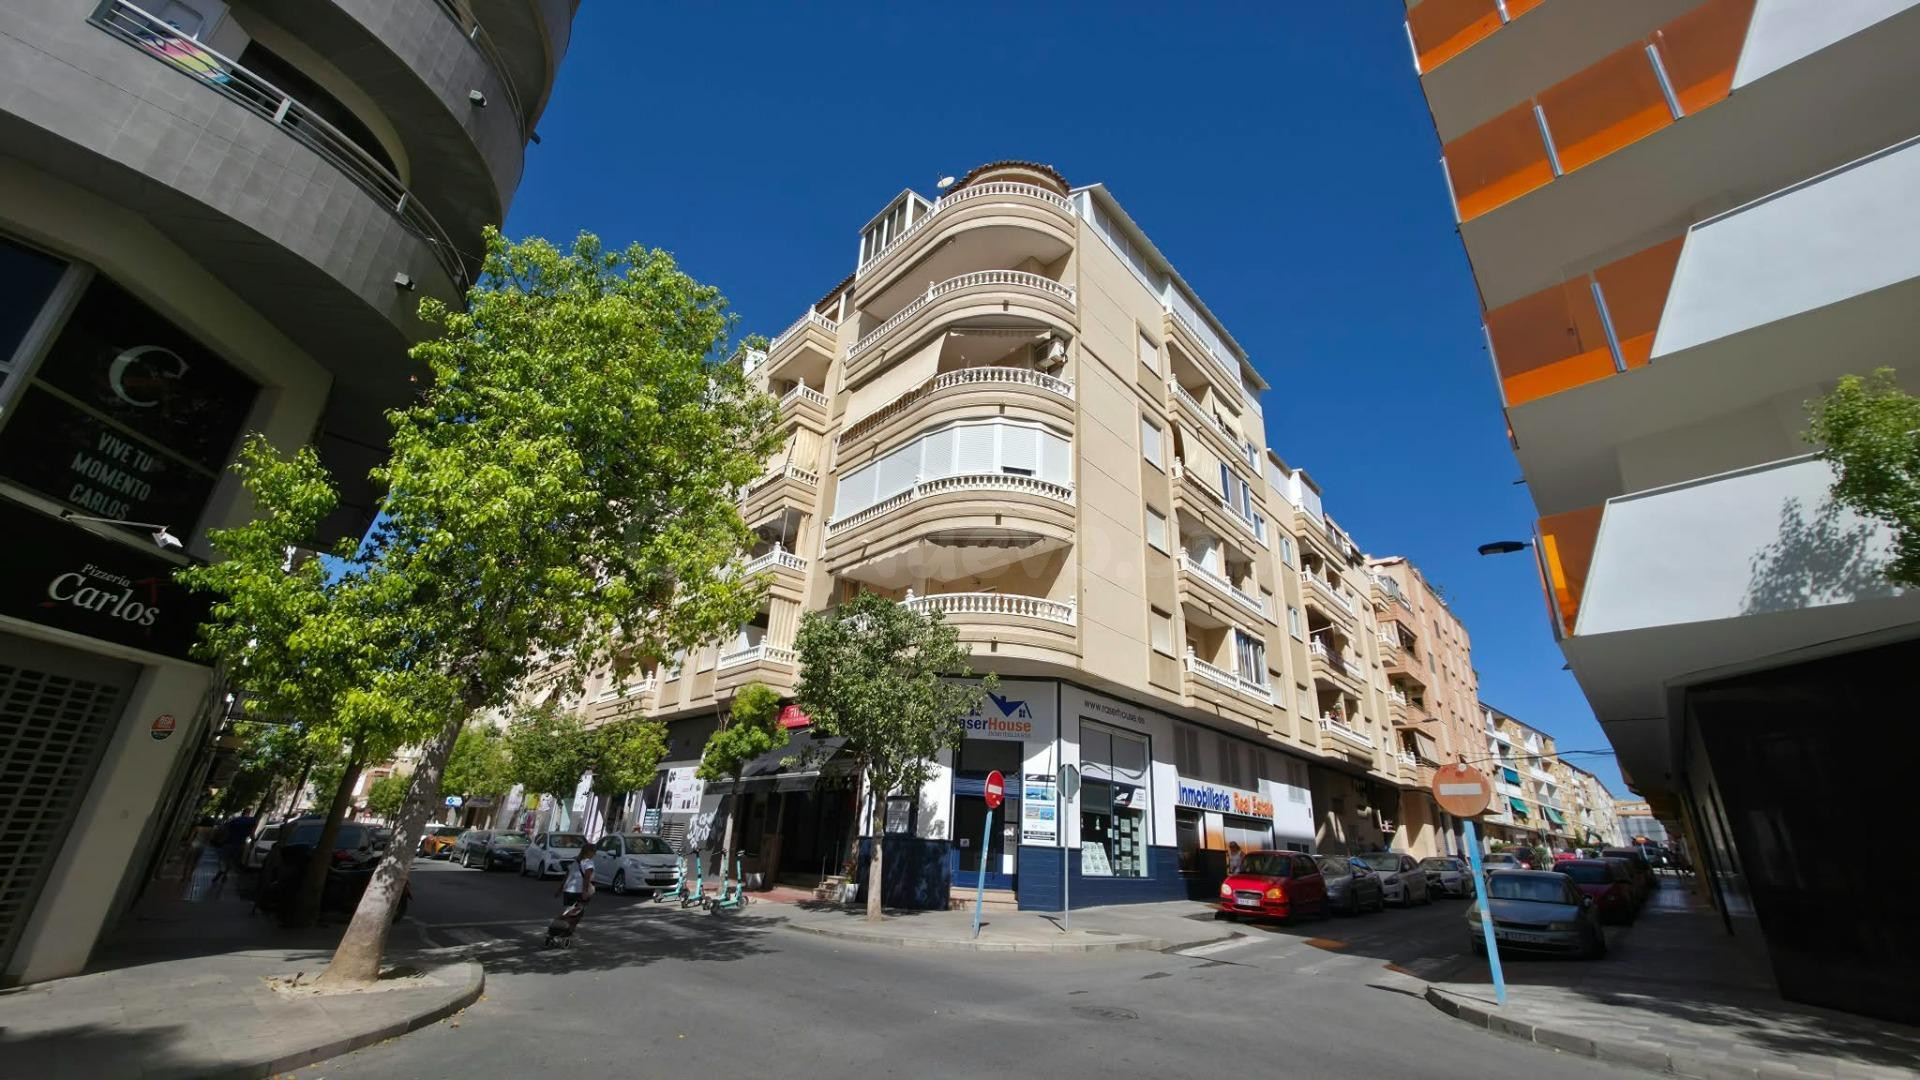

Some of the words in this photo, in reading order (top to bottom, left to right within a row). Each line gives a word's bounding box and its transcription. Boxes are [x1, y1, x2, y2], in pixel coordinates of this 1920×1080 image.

[98, 431, 134, 464] VIVE
[133, 448, 155, 473] TU
[70, 450, 152, 502] MOMENTO
[68, 482, 131, 521] CARLOS
[81, 562, 131, 587] Pizzeria
[47, 572, 160, 627] Carlos
[956, 716, 1032, 732] aserHouse
[1178, 780, 1230, 811] Inmobiliaria
[1233, 792, 1250, 815] Real
[1251, 796, 1274, 817] Estate
